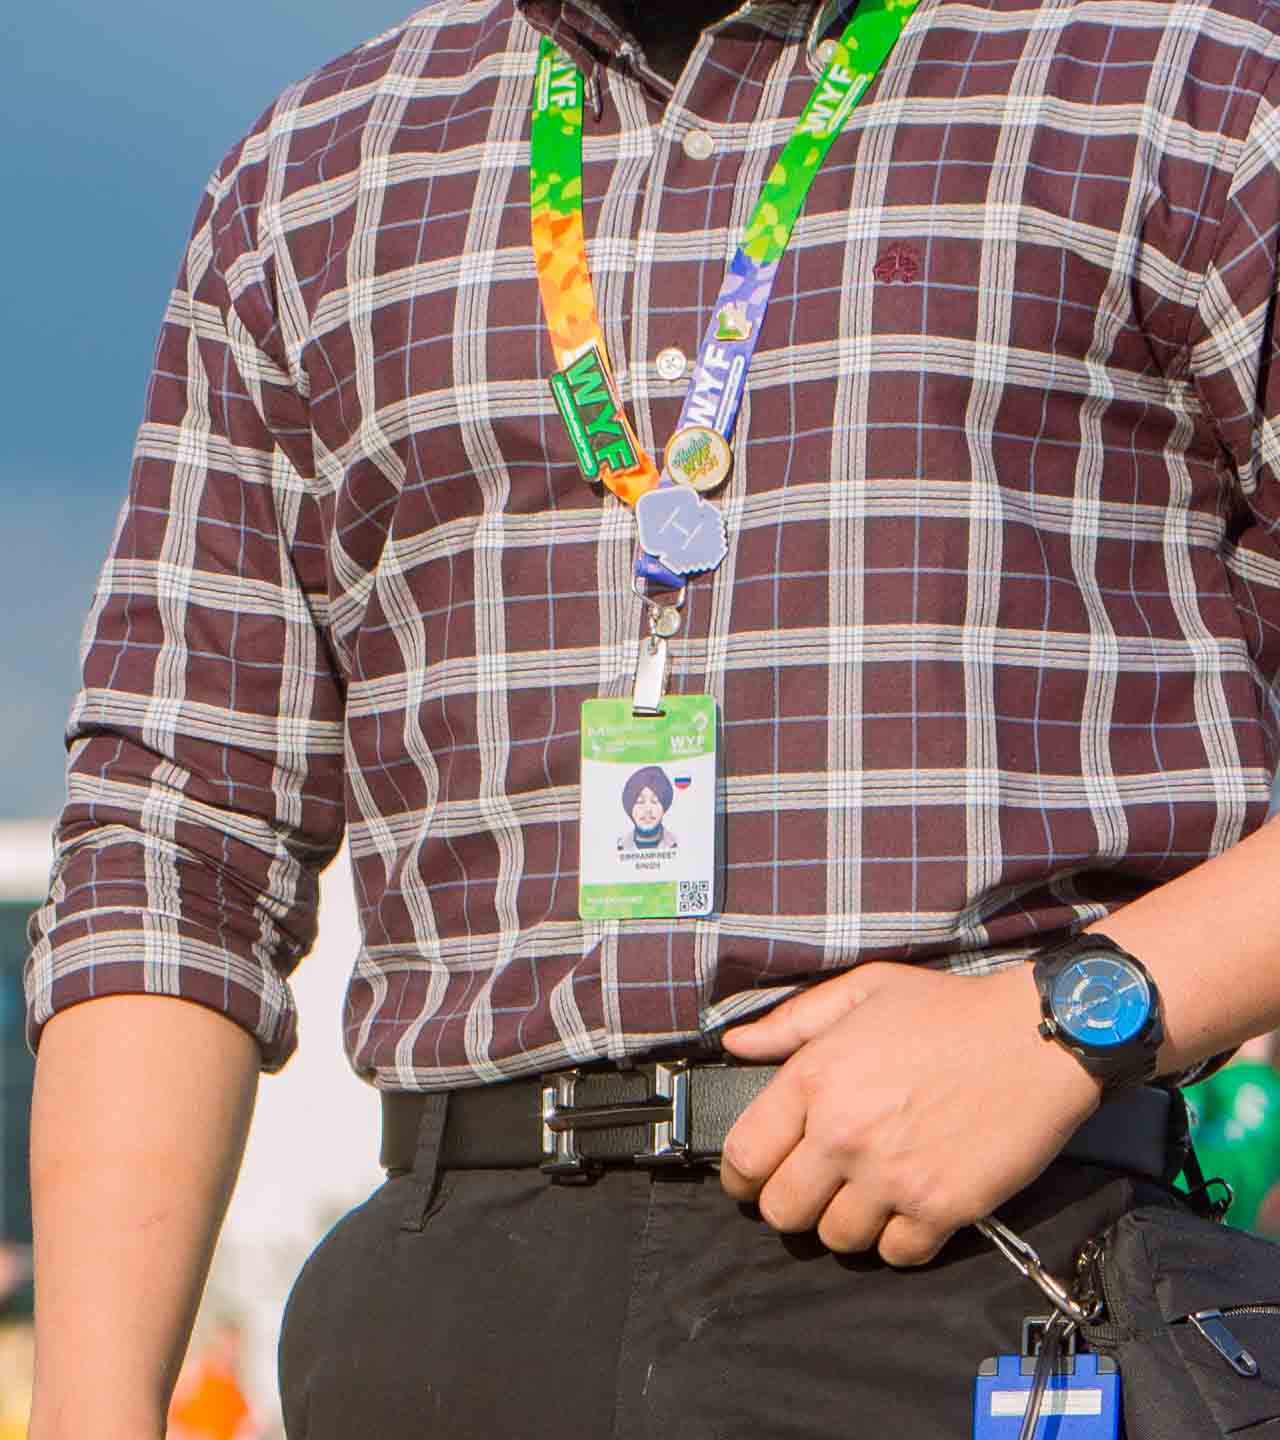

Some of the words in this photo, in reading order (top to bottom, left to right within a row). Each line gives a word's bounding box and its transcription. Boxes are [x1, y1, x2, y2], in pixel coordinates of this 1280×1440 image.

[799, 63, 852, 132] WYF
[566, 353, 634, 470] WYF
[682, 343, 731, 426] WYF
